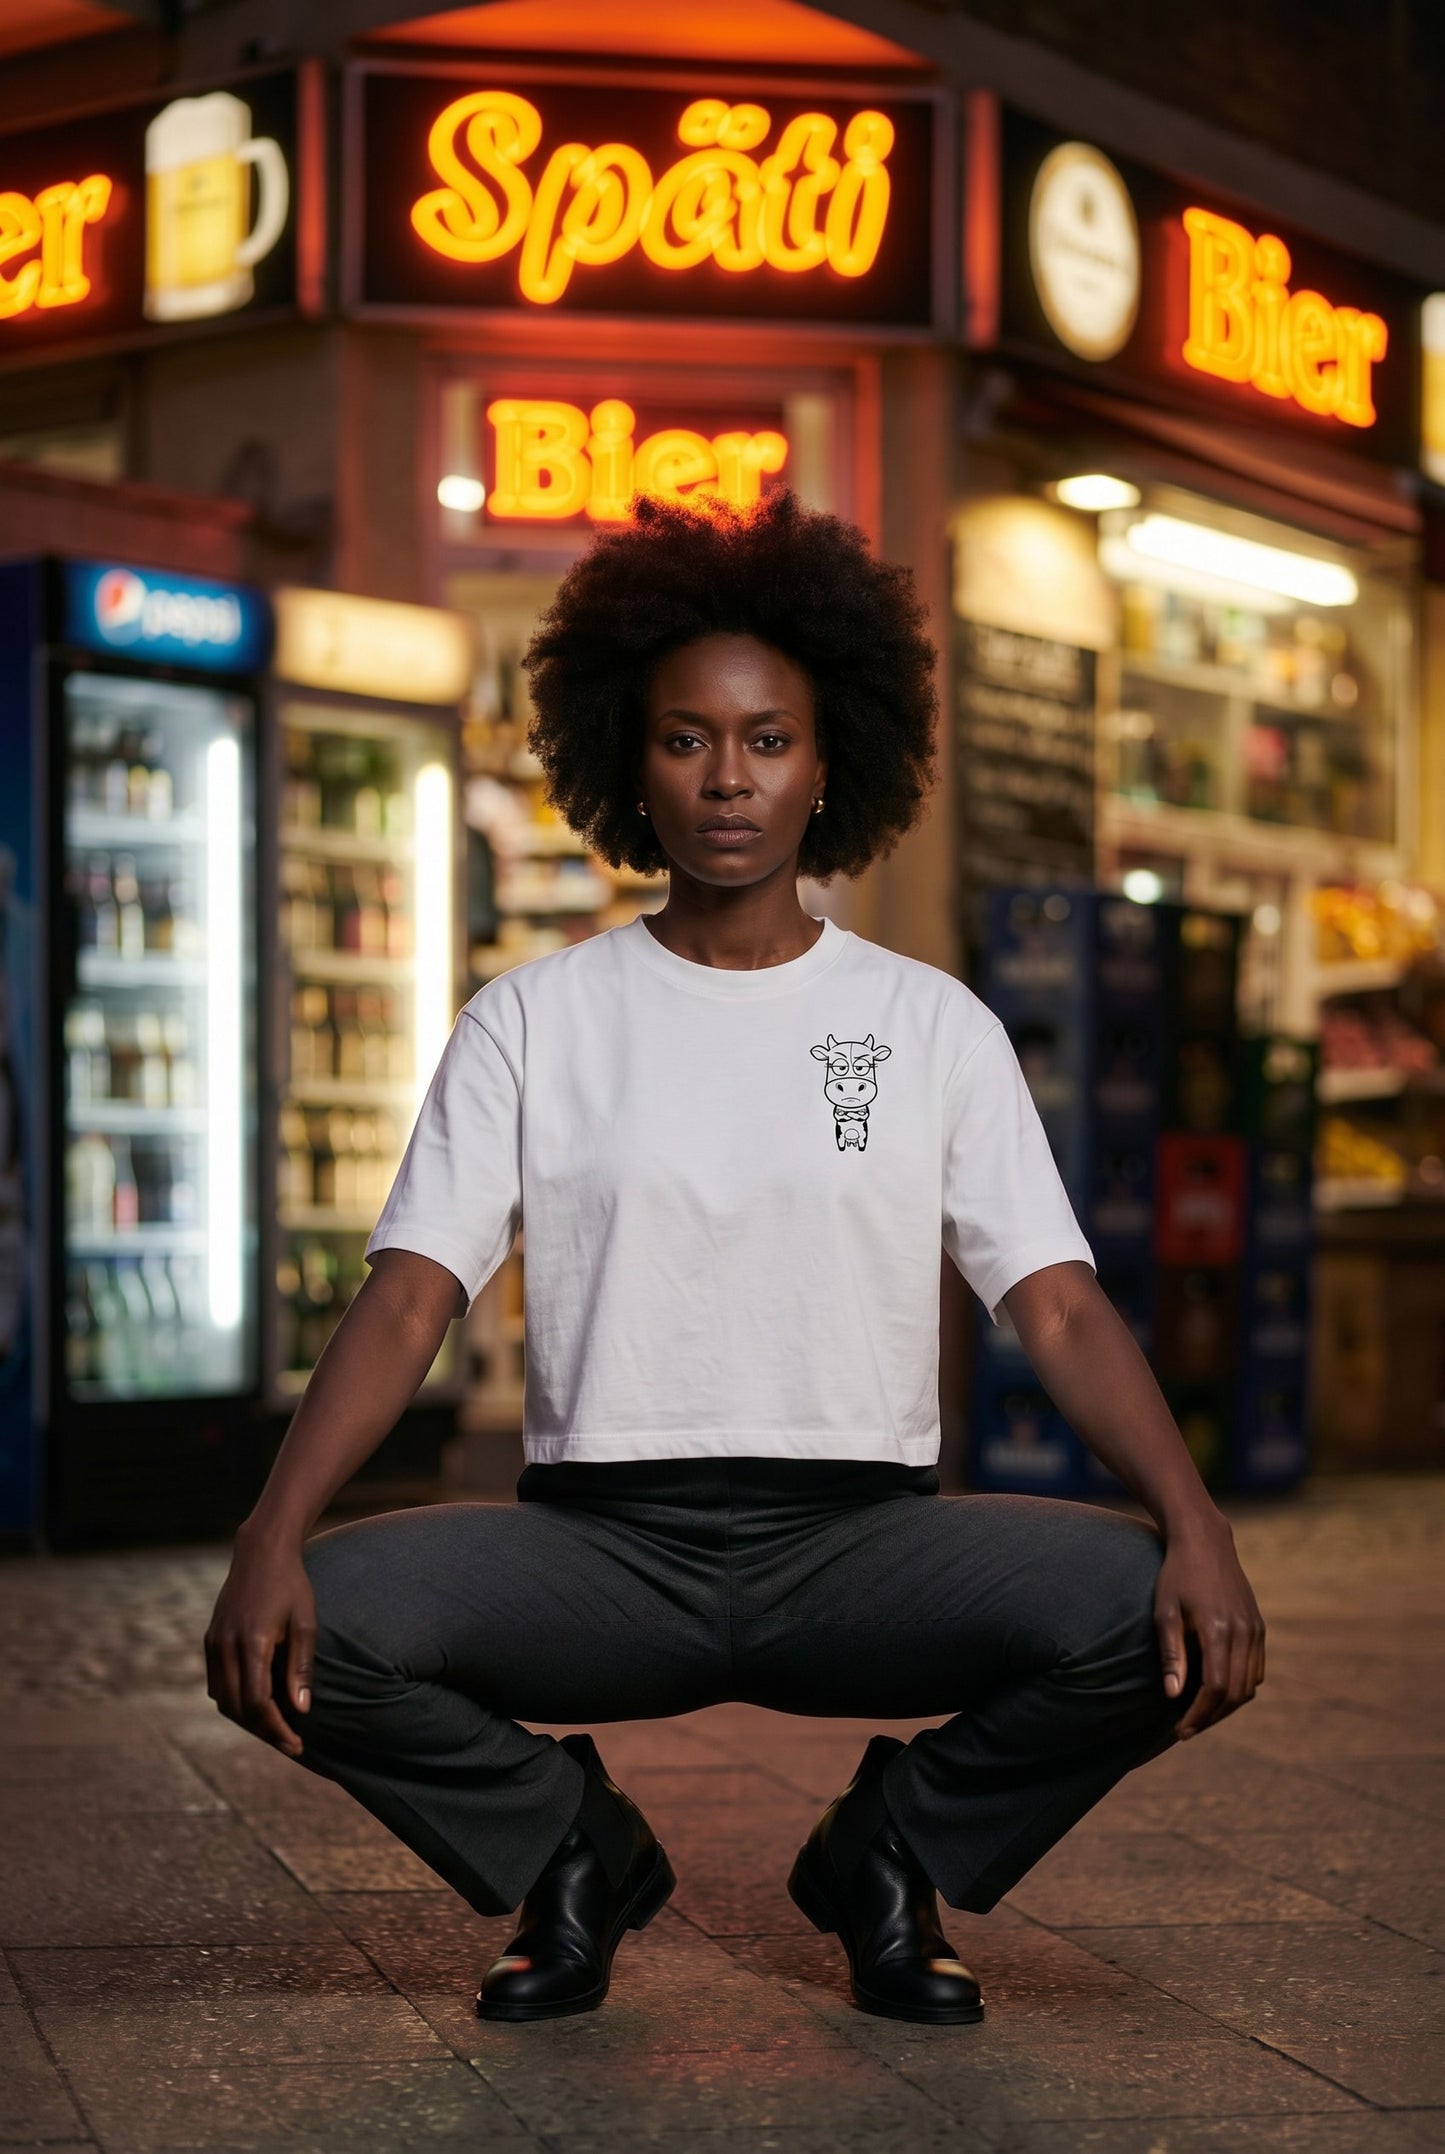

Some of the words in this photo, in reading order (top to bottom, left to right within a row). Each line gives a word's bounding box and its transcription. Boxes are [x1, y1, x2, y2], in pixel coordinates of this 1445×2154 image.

[411, 90, 895, 304] Späti
[1182, 206, 1388, 428] Bier
[487, 399, 788, 524] Bier
